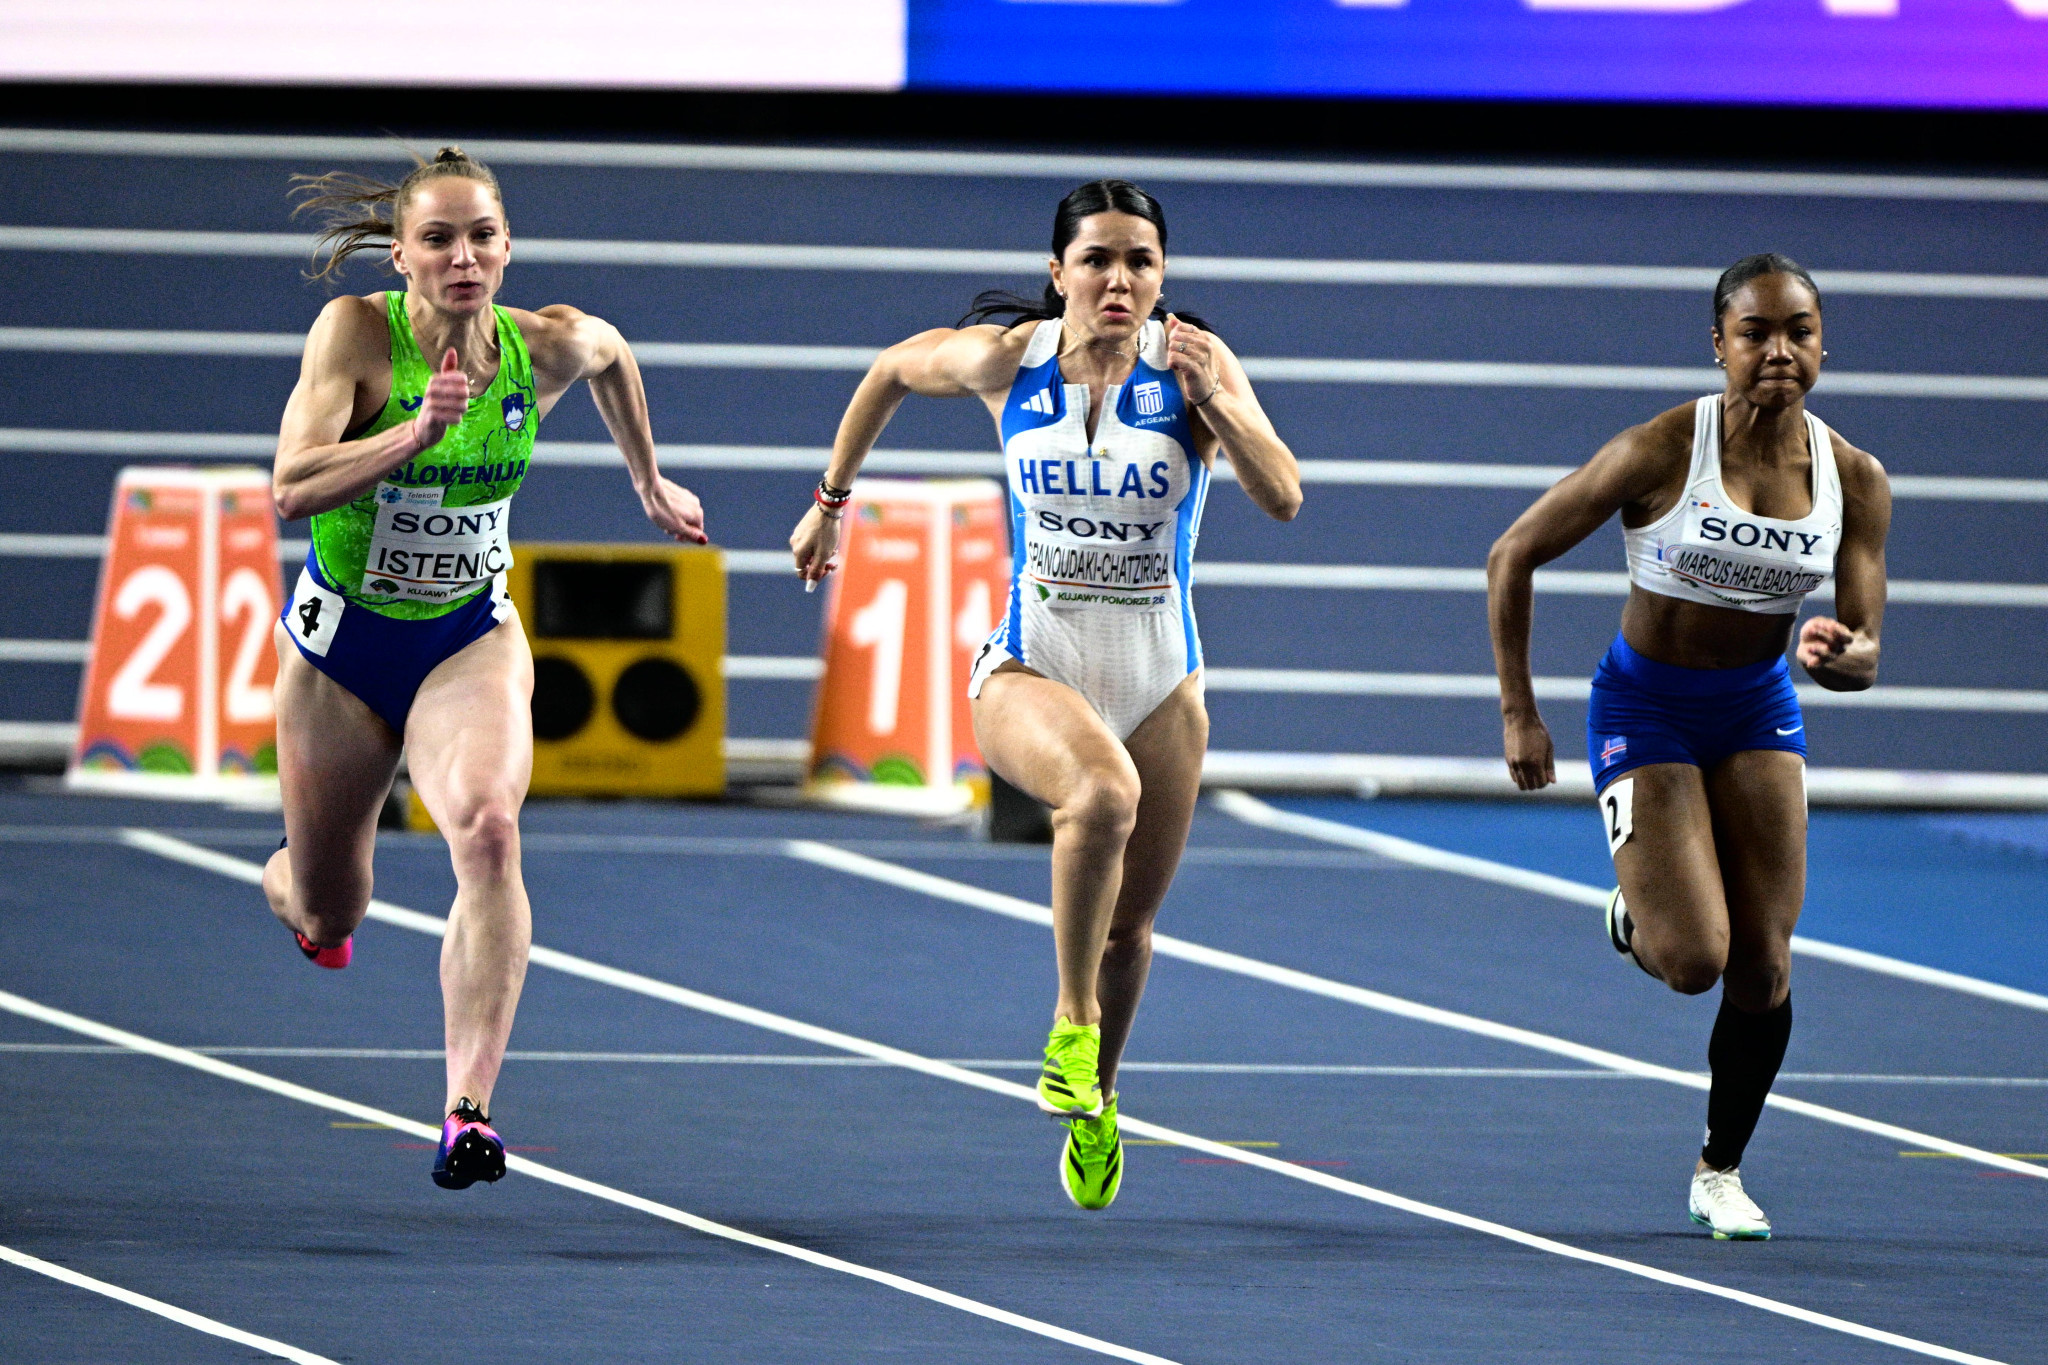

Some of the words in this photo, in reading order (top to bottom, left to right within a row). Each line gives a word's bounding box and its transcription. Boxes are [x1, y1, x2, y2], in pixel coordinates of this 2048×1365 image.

[1134, 416, 1171, 427] AEGEAN
[407, 491, 439, 499] Telekom
[1018, 458, 1170, 499] HELLAS
[391, 506, 503, 536] SONY
[1039, 510, 1164, 542] SONY
[1699, 517, 1822, 555] SONY
[377, 538, 506, 579] ISTENIČ
[1028, 541, 1169, 585] SPANOUDAKI-CHATZIRIGA
[1676, 551, 1733, 584] MARCUS
[407, 587, 448, 598] KUJAWY
[1057, 591, 1100, 604] KUJAWY
[1101, 595, 1151, 605] POMORZE
[1152, 594, 1166, 606] 26
[298, 596, 323, 639] 4
[107, 564, 194, 722] 2
[222, 566, 275, 723] 2
[850, 578, 909, 738] 1
[1606, 795, 1621, 843] 2
